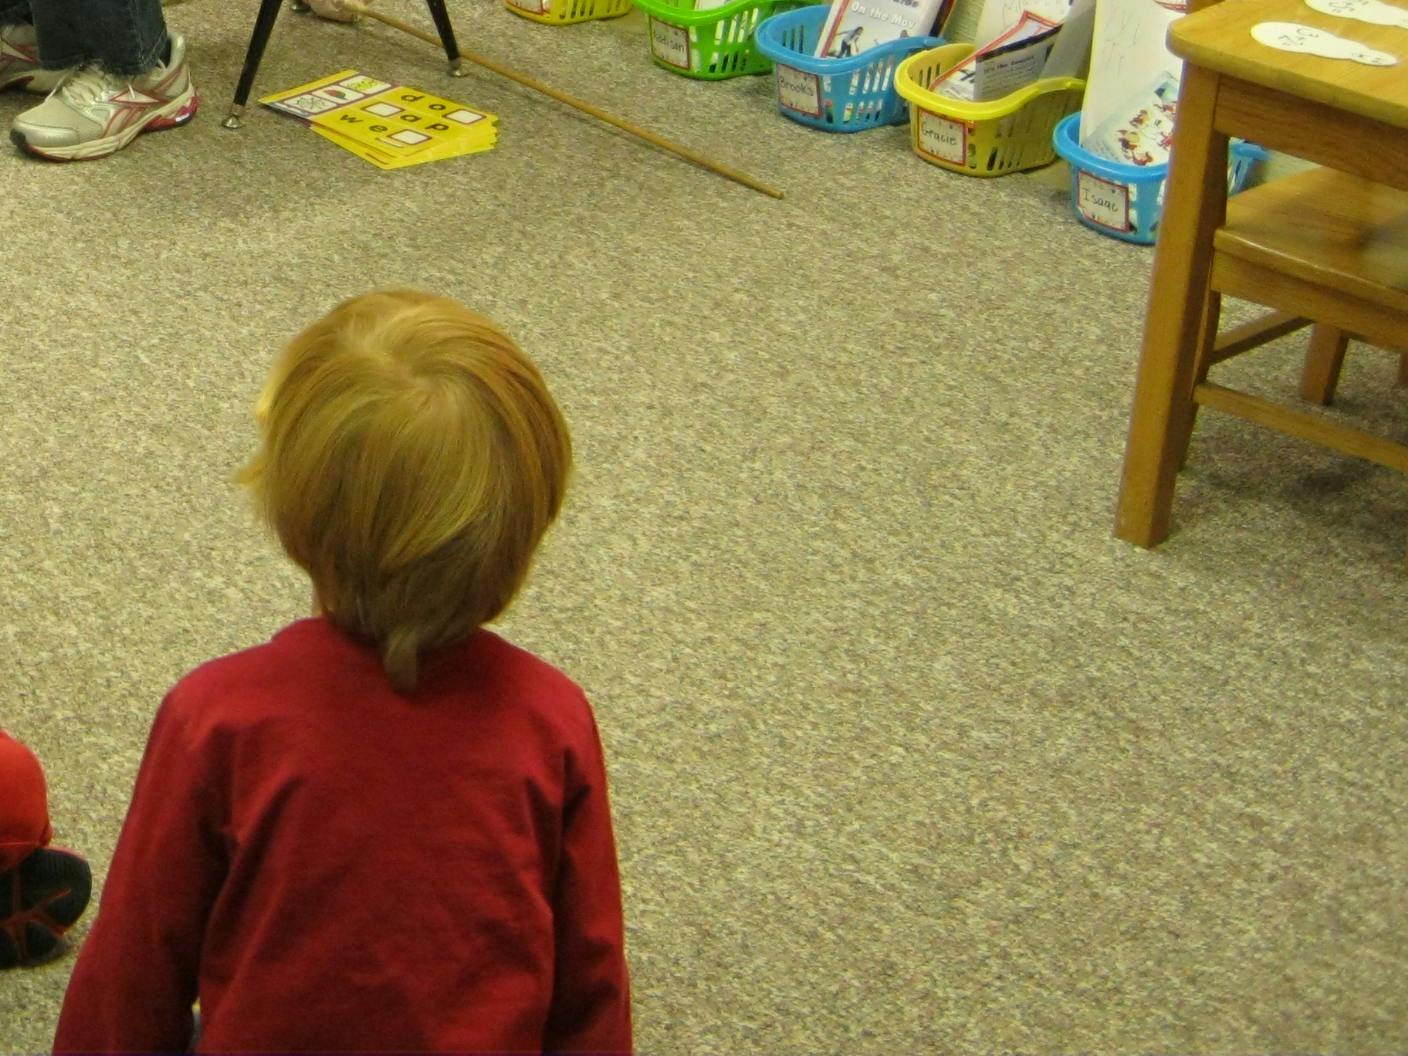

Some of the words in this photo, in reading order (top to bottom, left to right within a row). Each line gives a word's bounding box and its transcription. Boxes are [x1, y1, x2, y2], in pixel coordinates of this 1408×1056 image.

[870, 5, 888, 21] the
[779, 76, 814, 97] Brooks
[1082, 187, 1119, 213] Isaac
